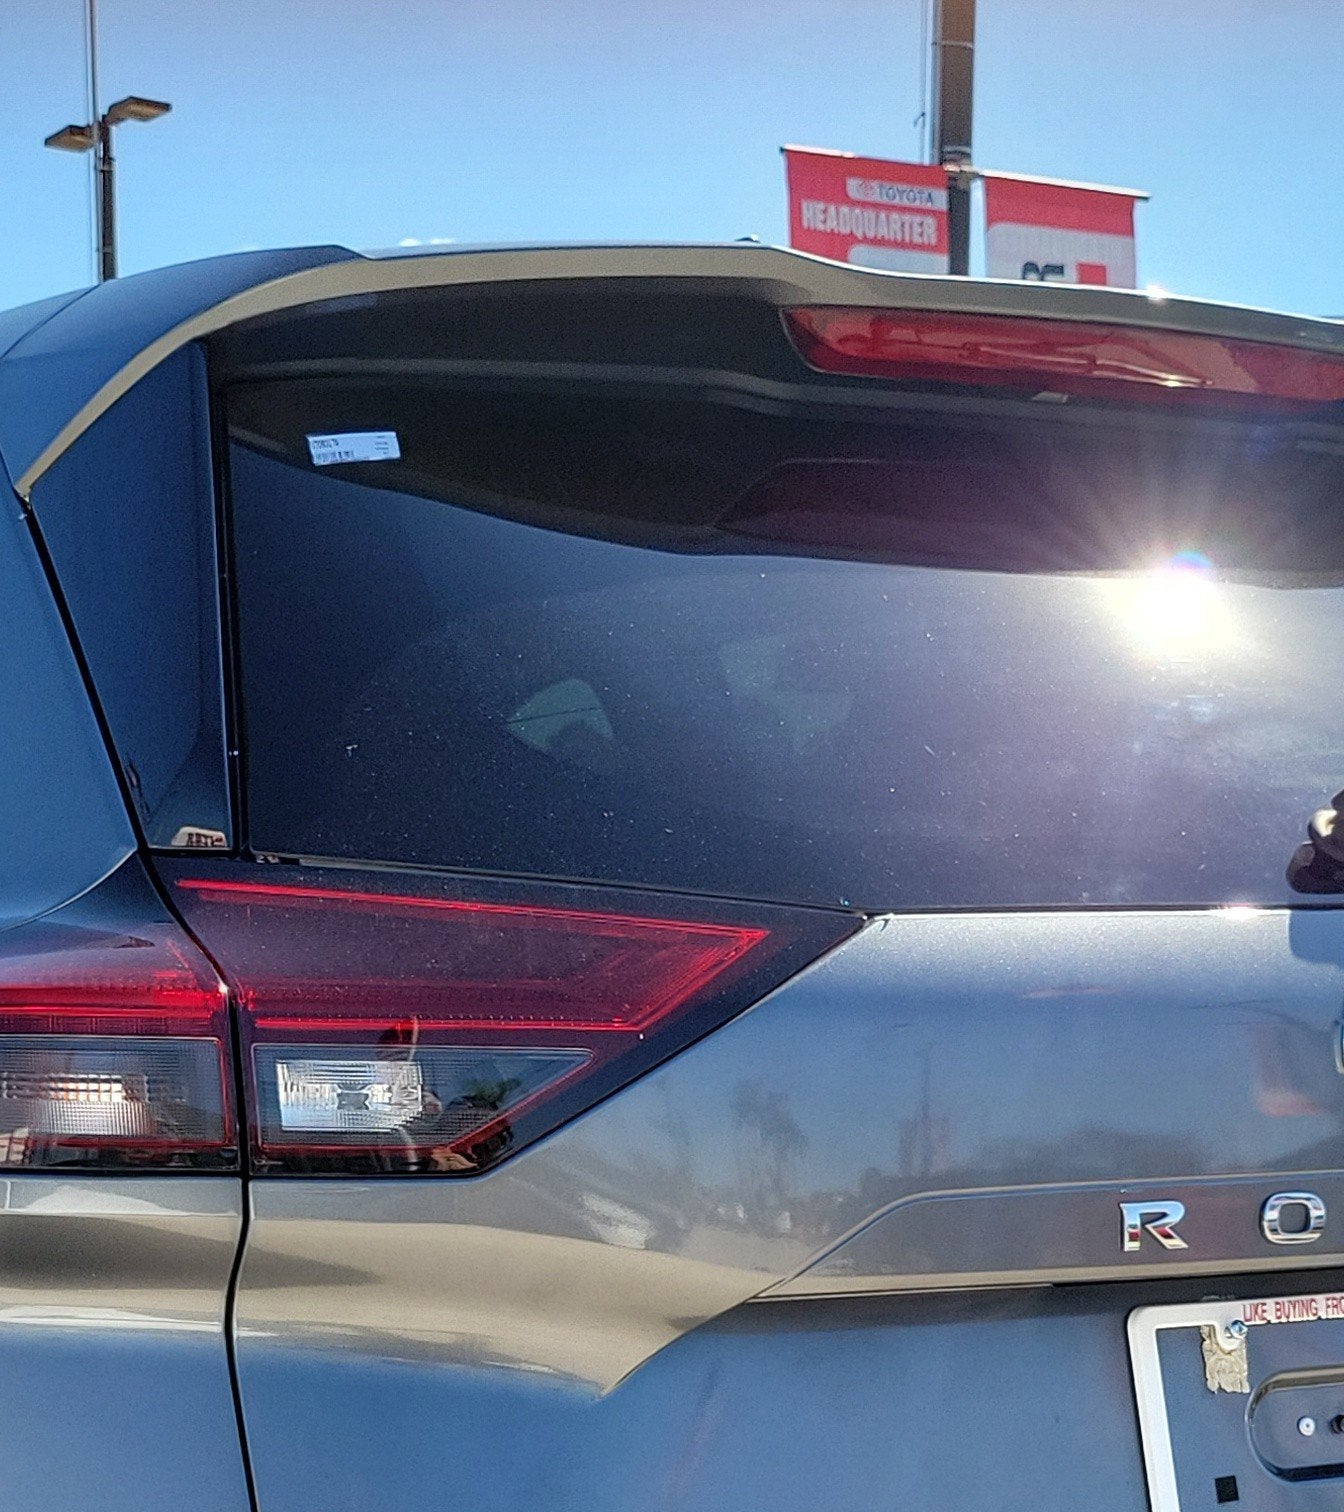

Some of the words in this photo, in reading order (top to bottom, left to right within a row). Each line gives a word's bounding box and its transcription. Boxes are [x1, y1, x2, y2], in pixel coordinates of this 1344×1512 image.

[877, 184, 934, 206] TOYOTA
[801, 199, 938, 246] HEADQUARTER
[1242, 1302, 1267, 1323] LIKE
[1274, 1300, 1318, 1320] BUYING
